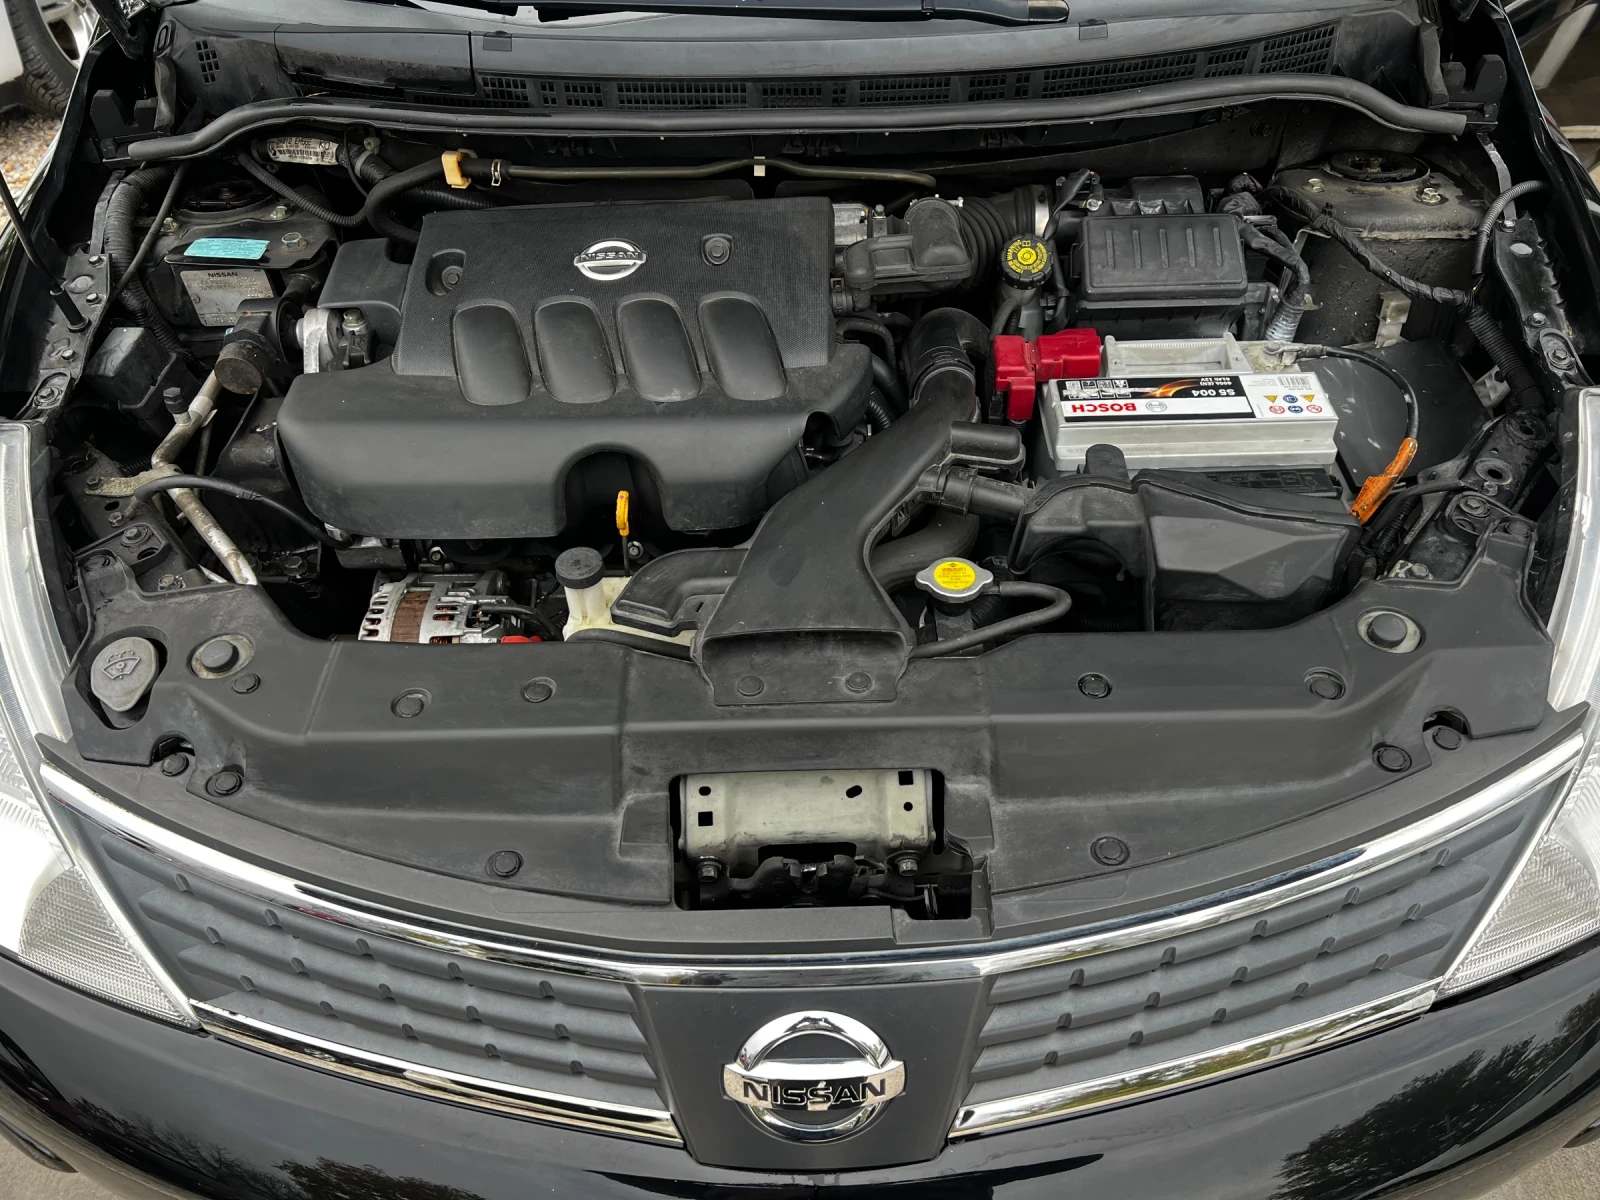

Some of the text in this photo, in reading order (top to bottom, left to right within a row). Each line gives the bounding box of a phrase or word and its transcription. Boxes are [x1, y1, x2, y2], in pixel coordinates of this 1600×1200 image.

[580, 251, 639, 261] NISSAN
[1191, 388, 1236, 397] S5 004
[1072, 403, 1137, 413] BOSCH
[743, 1078, 887, 1105] NISSAN
